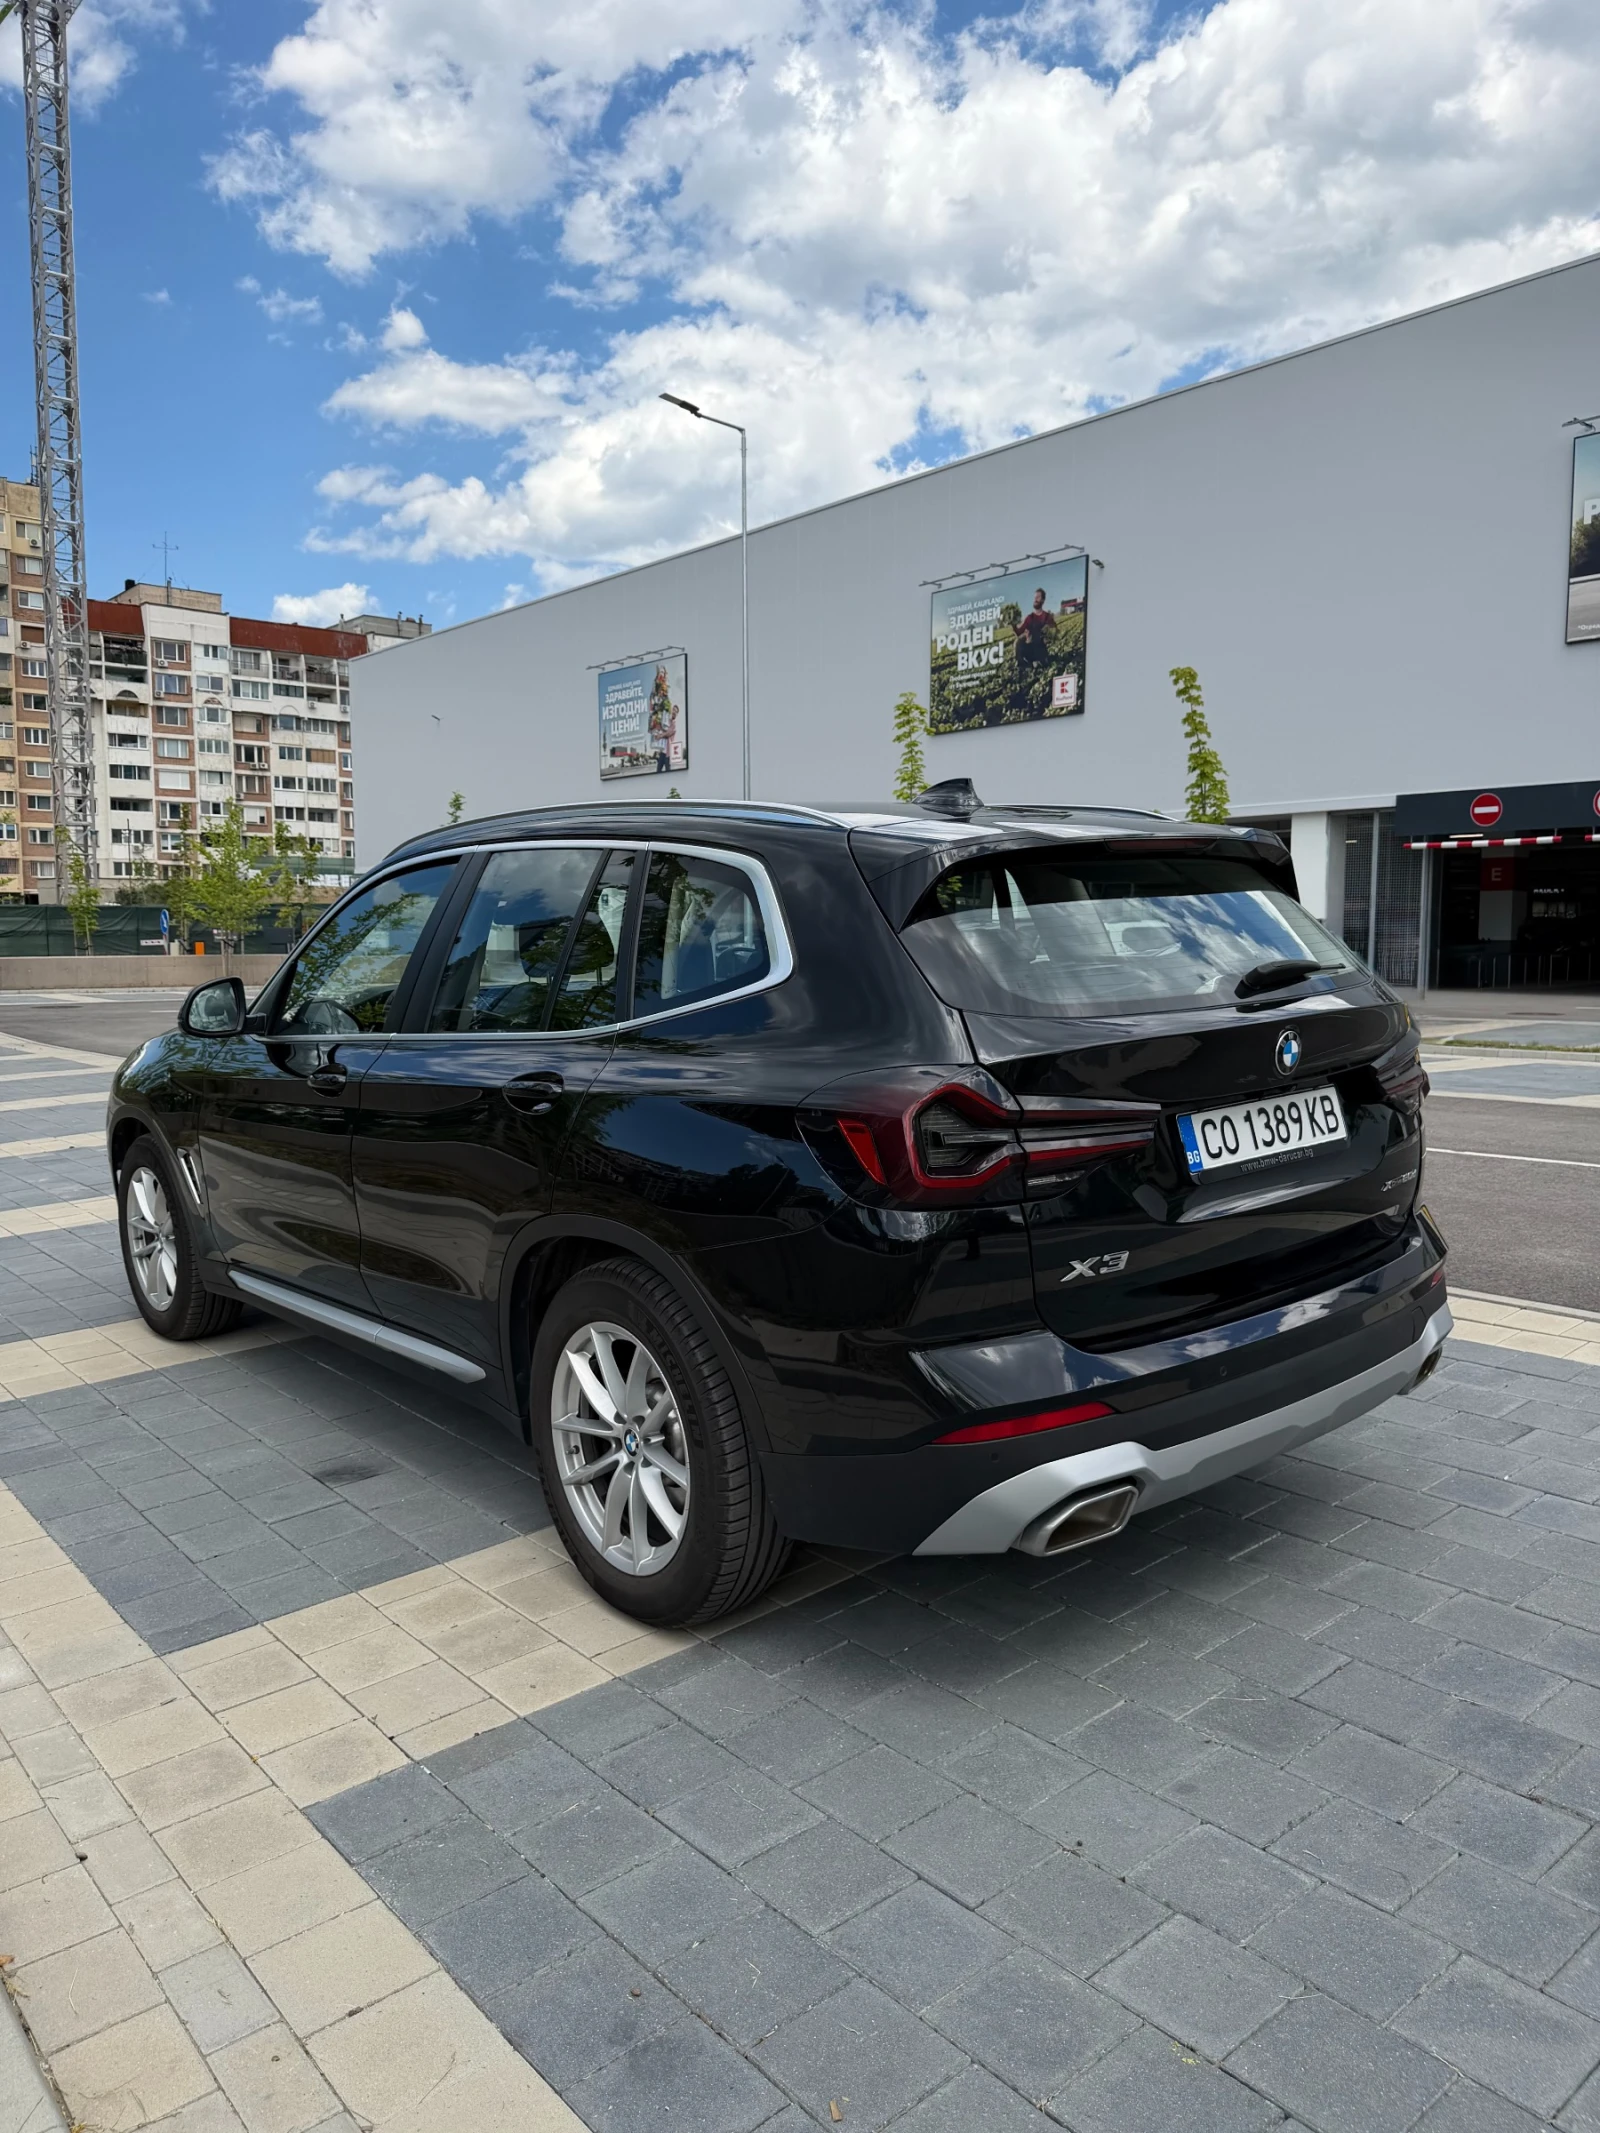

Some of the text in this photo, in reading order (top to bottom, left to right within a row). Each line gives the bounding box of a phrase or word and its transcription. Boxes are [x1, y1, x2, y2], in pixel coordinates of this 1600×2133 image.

[950, 603, 1003, 630] ЗДРАВЕЙ,
[936, 625, 994, 653] РОДЕН
[957, 640, 1004, 671] ВКУС!
[602, 697, 648, 720] ИЗГОДНИ
[610, 714, 640, 737] ЦЕНИ!
[1491, 867, 1502, 881] E
[1187, 1150, 1200, 1165] BG
[1060, 1250, 1129, 1282] X3
